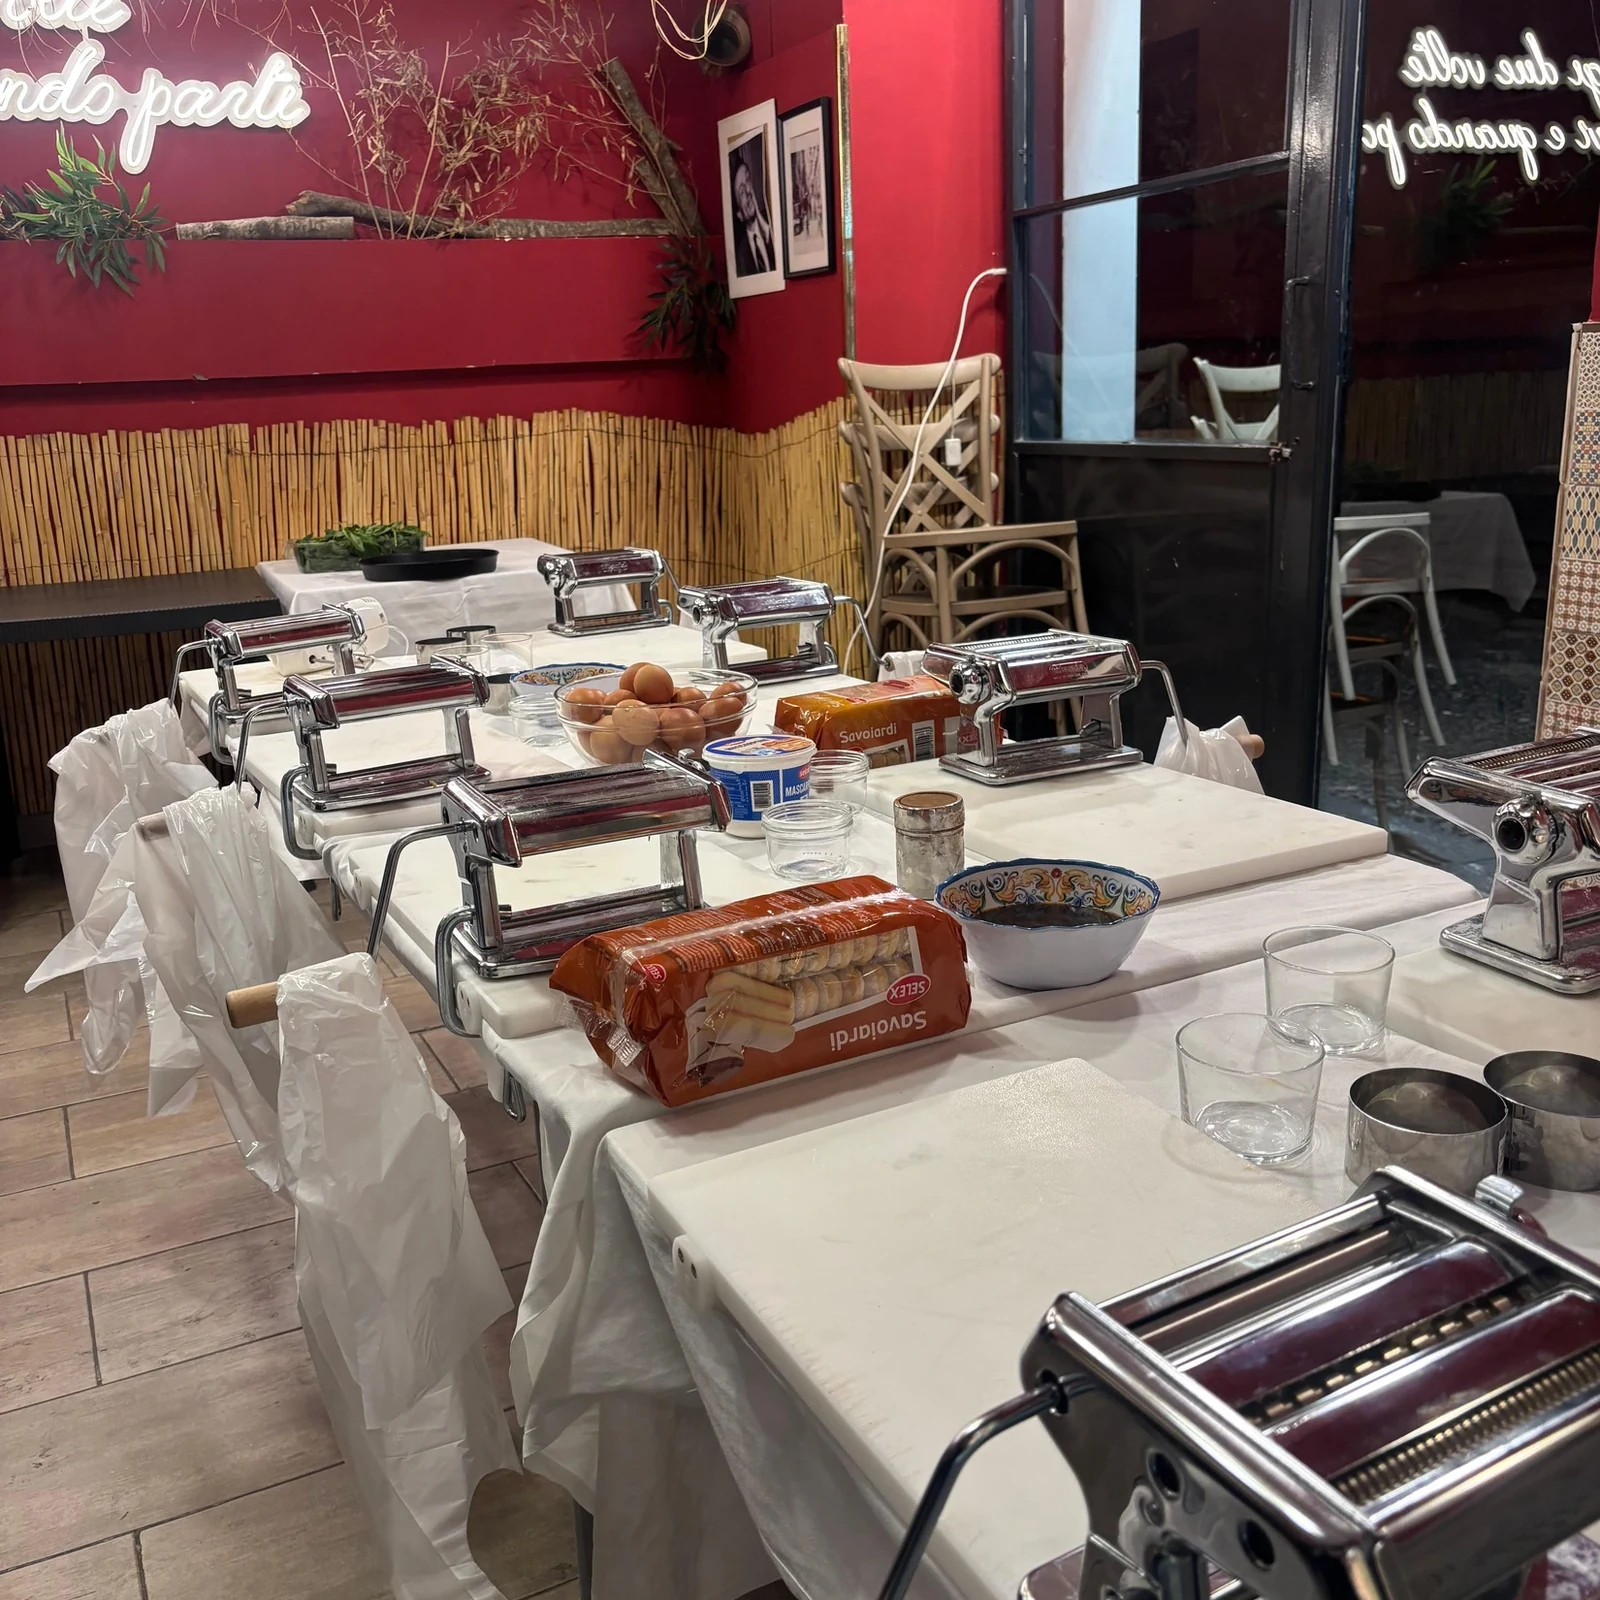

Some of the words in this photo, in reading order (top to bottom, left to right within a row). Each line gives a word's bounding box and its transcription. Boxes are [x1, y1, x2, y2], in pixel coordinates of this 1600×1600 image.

[839, 722, 897, 744] Savoiardi
[888, 980, 927, 1001] SELEX
[829, 1009, 928, 1053] Savoiardi
